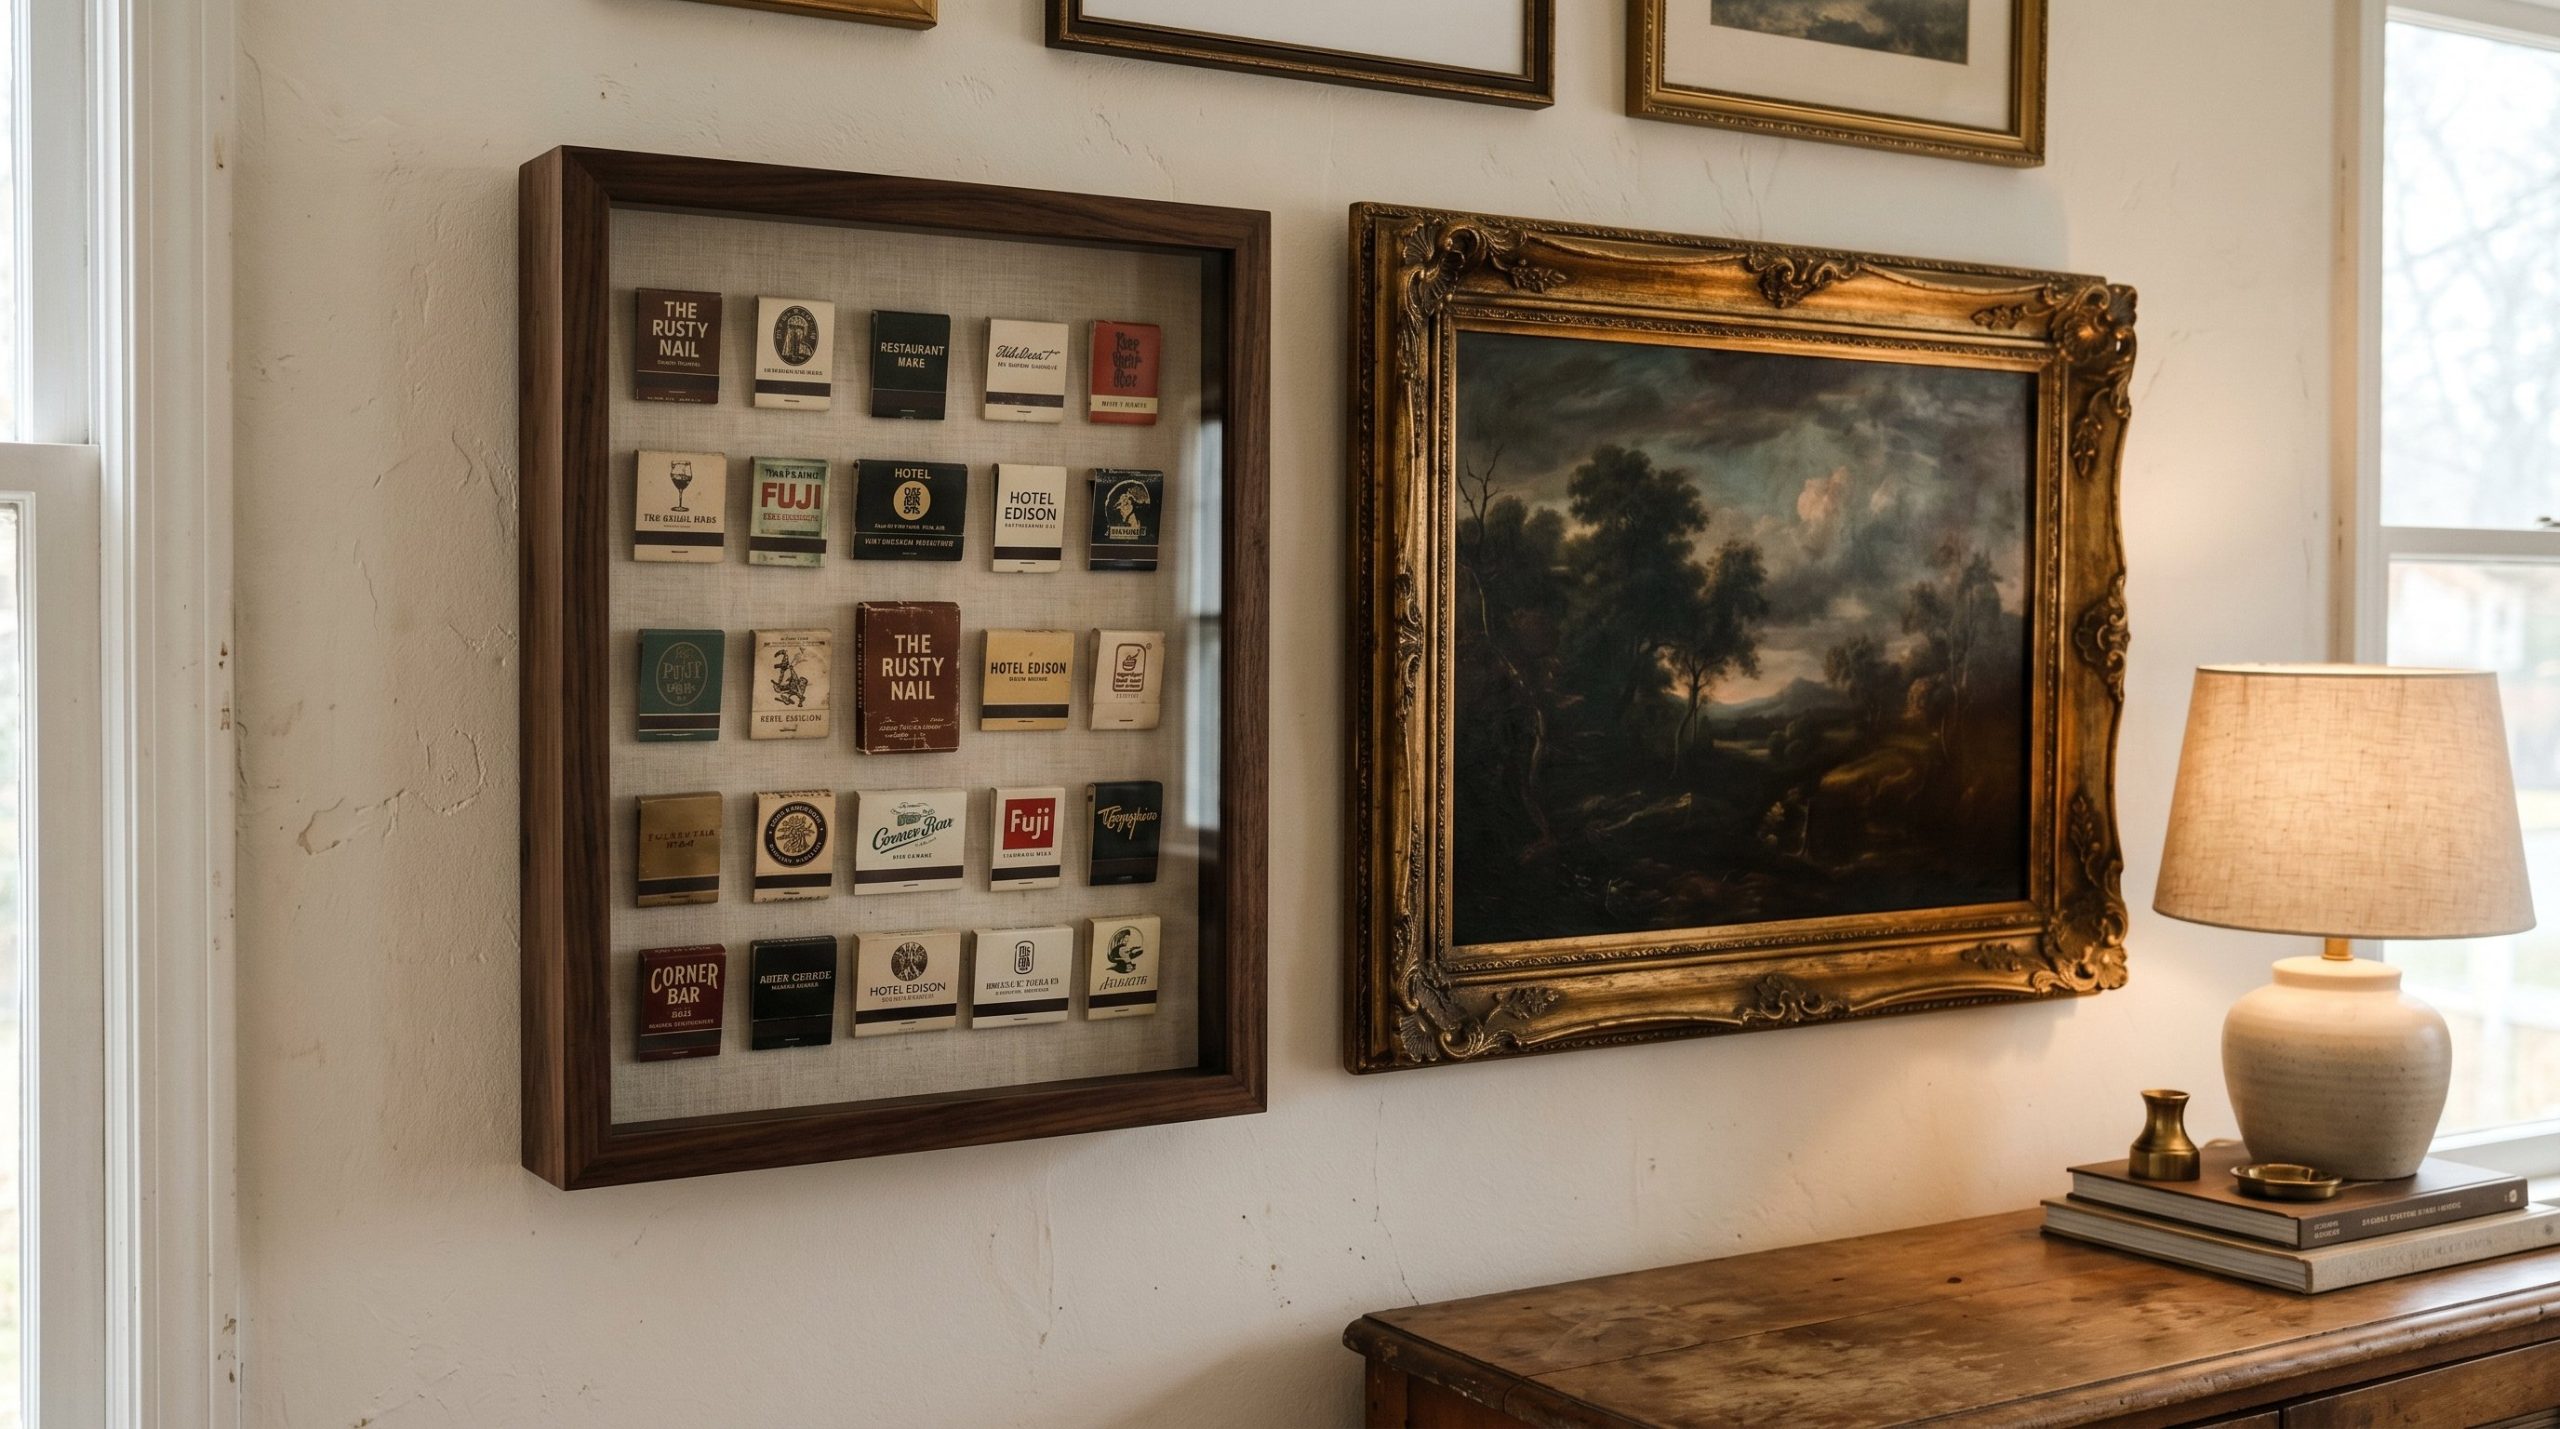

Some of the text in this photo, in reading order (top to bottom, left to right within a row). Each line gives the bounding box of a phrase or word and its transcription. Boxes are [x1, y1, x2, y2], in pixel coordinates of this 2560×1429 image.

[664, 301, 697, 319] THE
[652, 319, 709, 339] RUSTY
[659, 339, 699, 358] NAIL
[880, 341, 945, 357] RESTAURANT
[895, 467, 931, 480] HOTEL
[761, 482, 821, 509] FUJI
[1010, 491, 1055, 505] HOTEL
[1004, 507, 1057, 521] EDISON
[894, 634, 931, 654] THE
[882, 657, 944, 677] RUSTY
[990, 662, 1067, 675] HOTEL EDISON
[891, 681, 935, 701] NAIL
[1010, 807, 1050, 840] Fuji
[651, 963, 719, 994] CORNER
[667, 987, 700, 1006] BAR
[870, 981, 947, 997] HOTEL EDISON
